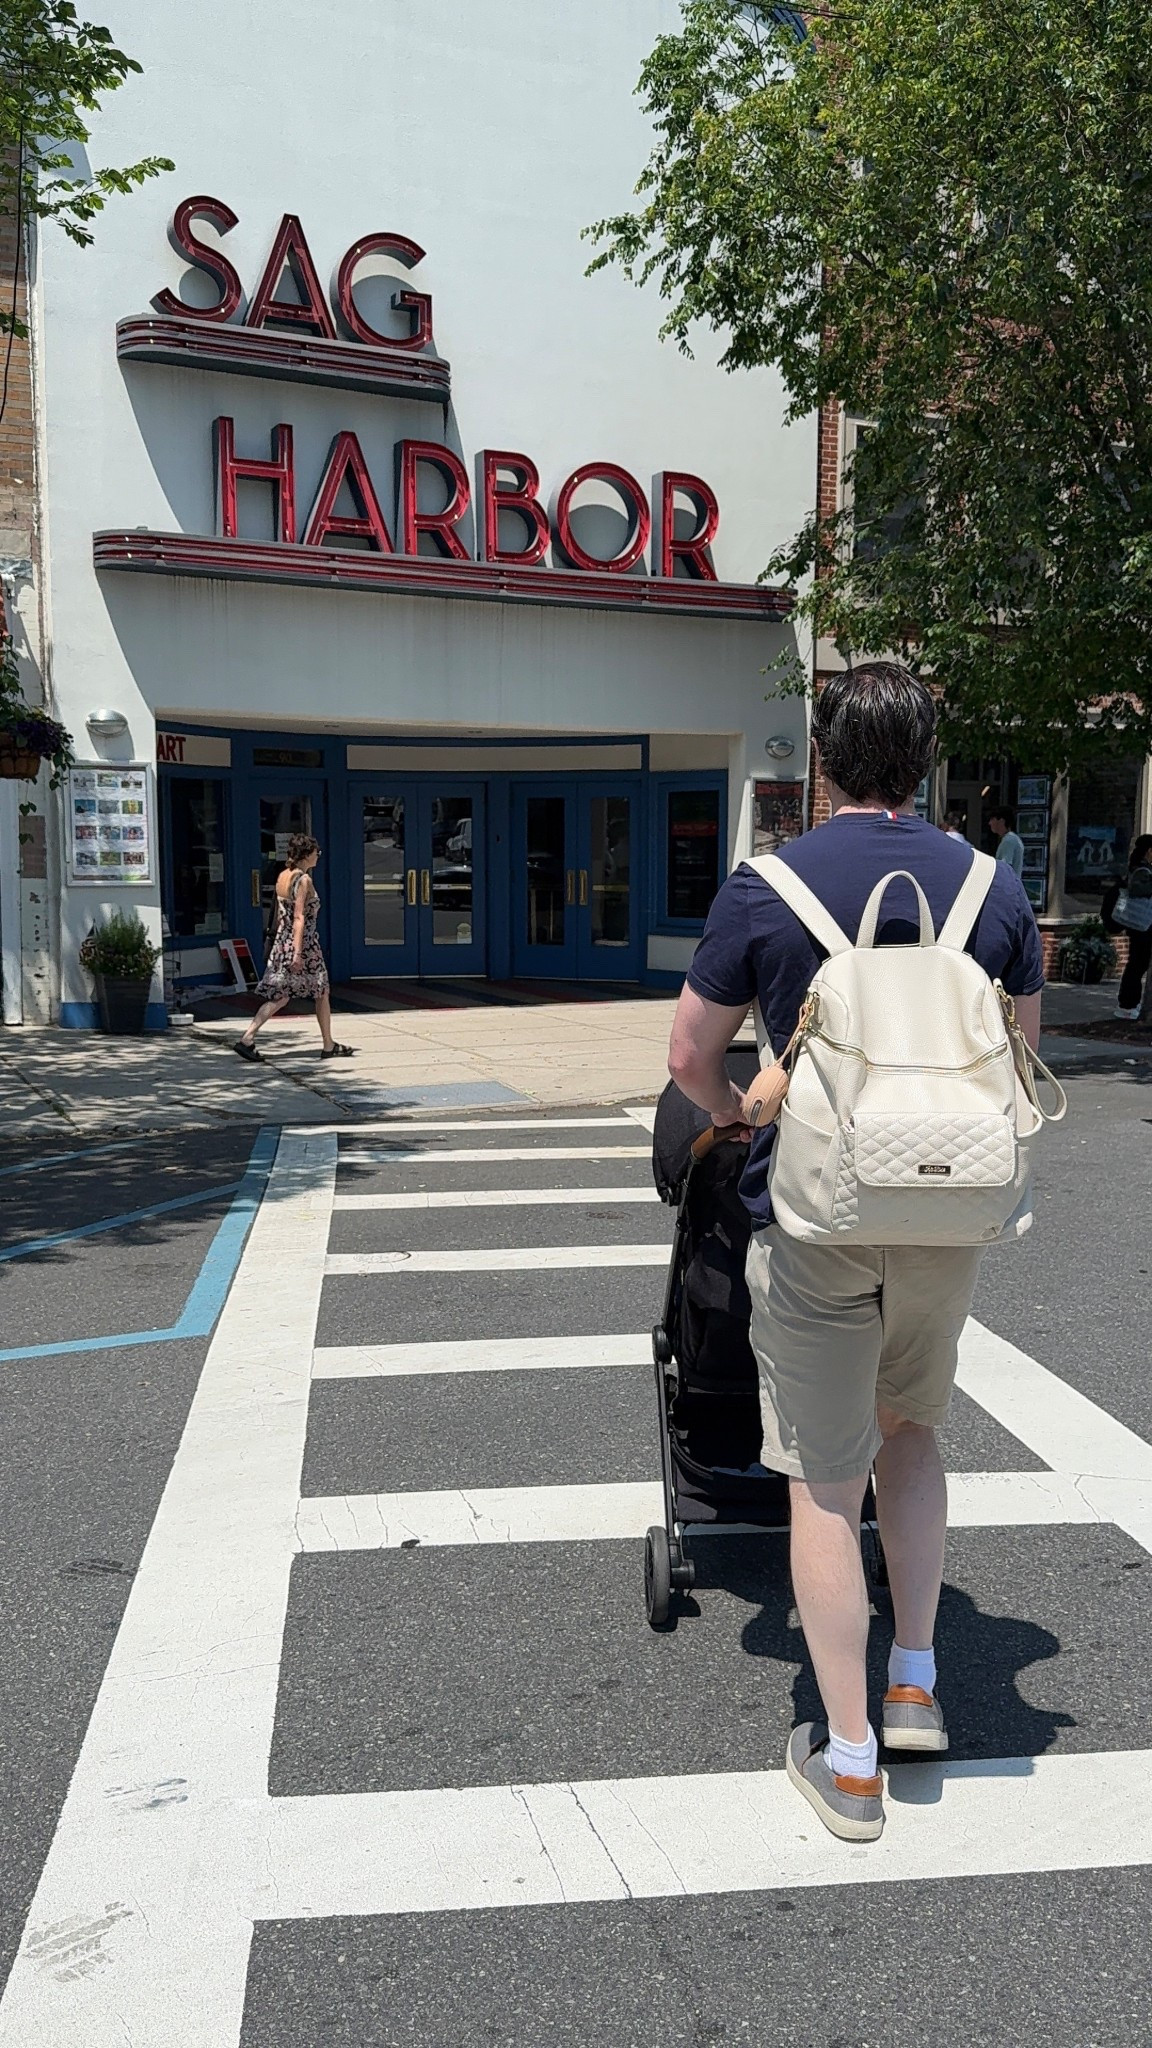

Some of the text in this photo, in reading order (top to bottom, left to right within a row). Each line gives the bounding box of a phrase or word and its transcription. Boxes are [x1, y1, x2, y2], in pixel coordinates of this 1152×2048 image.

[150, 195, 433, 351] SAG
[212, 416, 720, 581] HARBOR
[157, 733, 186, 762] ART
